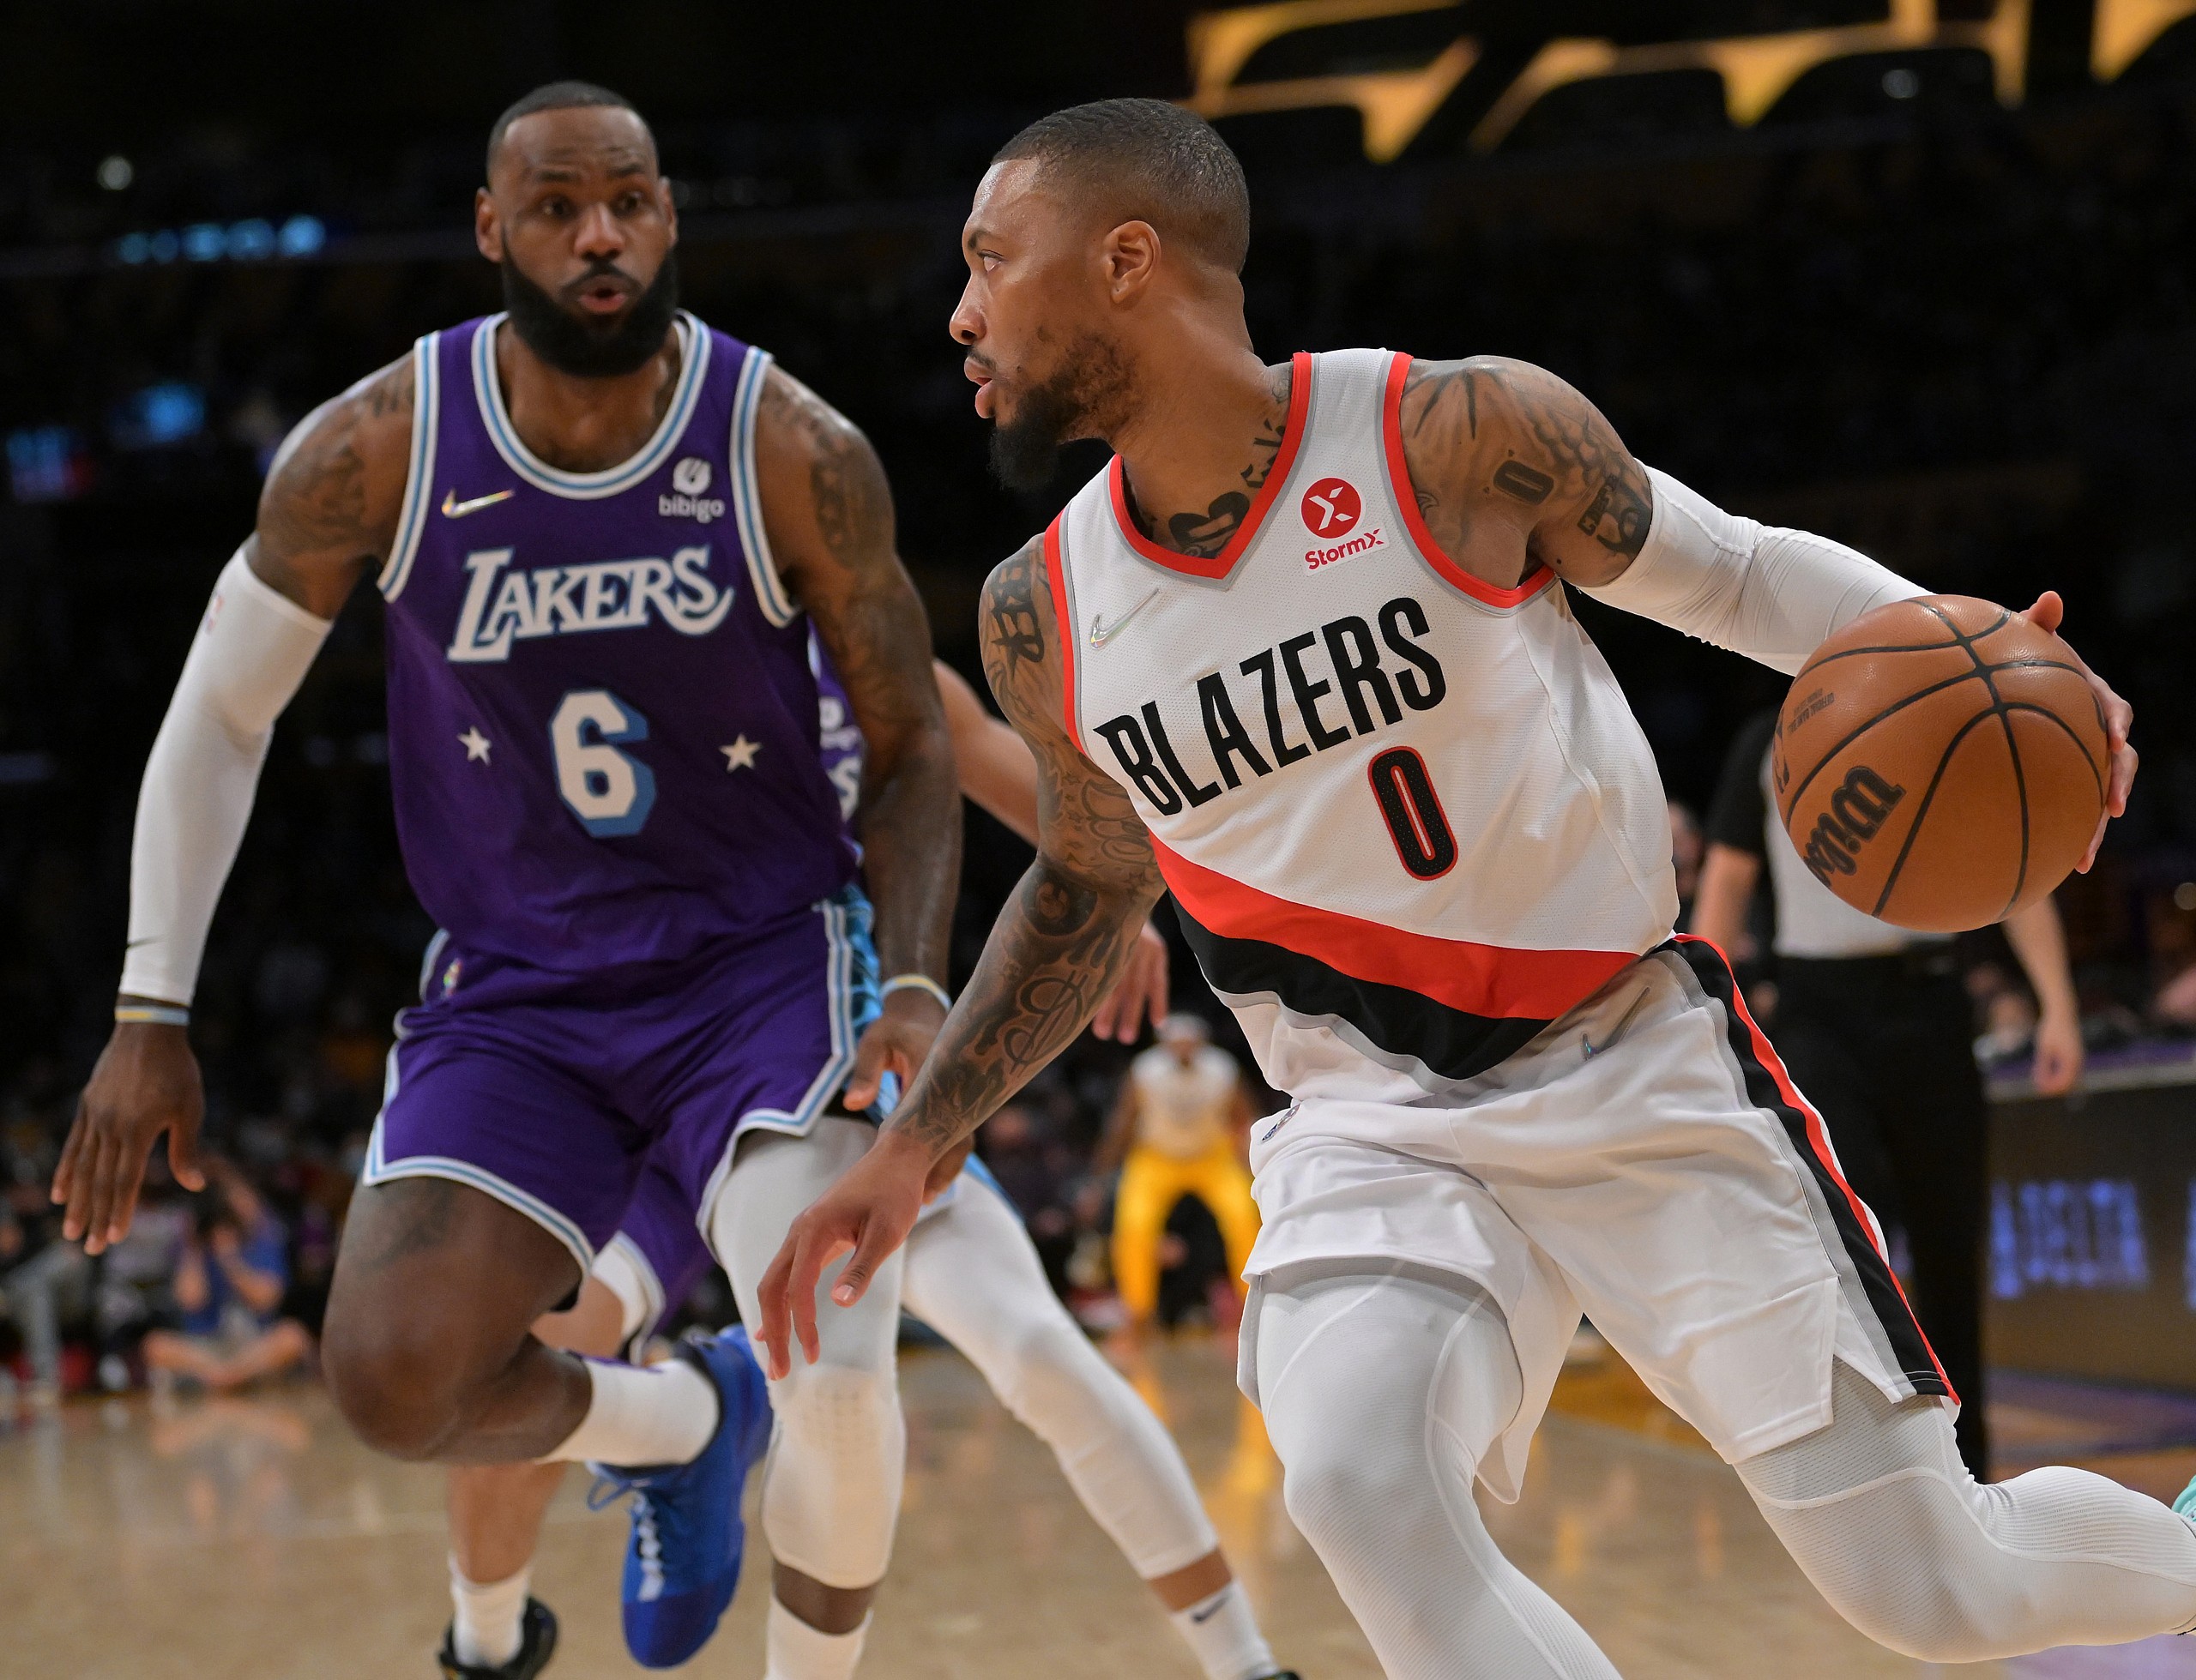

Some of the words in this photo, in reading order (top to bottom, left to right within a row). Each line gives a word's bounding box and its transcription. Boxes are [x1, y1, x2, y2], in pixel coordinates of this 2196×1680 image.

[658, 493, 726, 524] bibigo
[1305, 528, 1385, 570] StormX
[549, 689, 656, 839] 6
[1093, 597, 1447, 816] BLAZERS
[1367, 744, 1459, 882] 0
